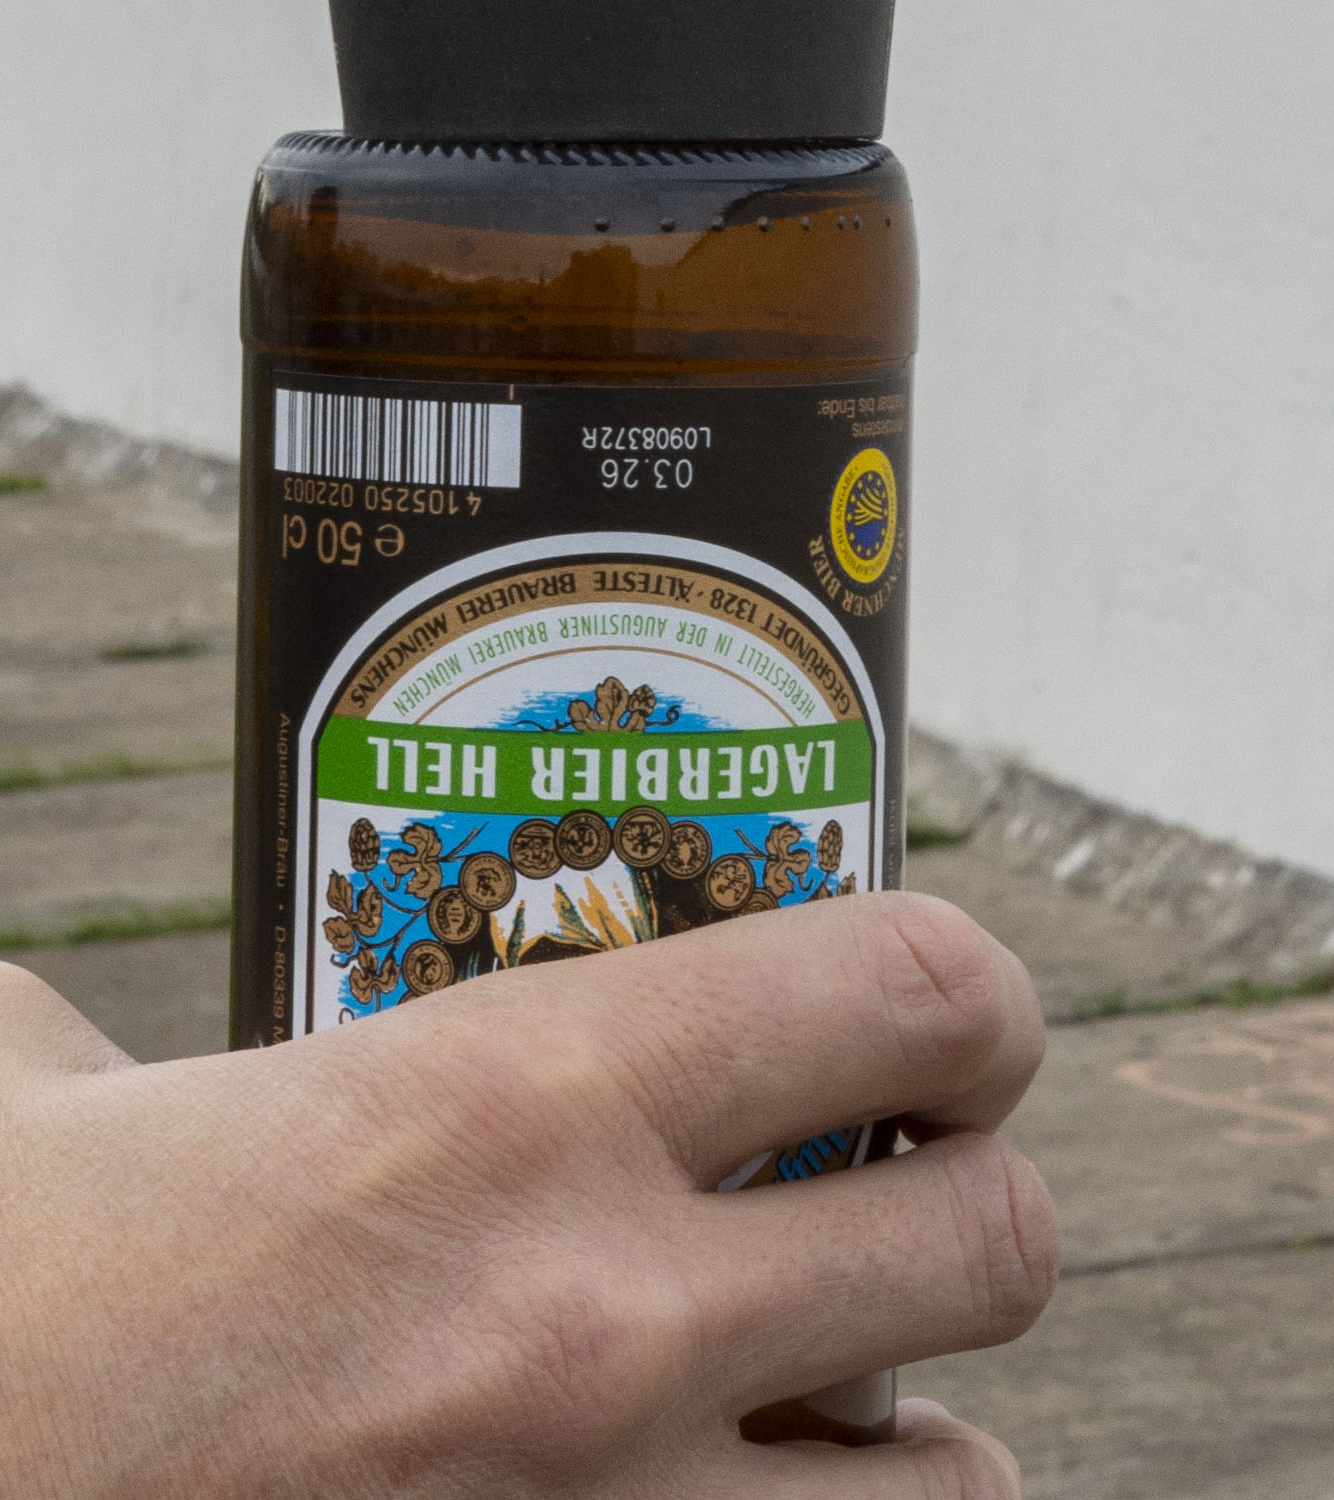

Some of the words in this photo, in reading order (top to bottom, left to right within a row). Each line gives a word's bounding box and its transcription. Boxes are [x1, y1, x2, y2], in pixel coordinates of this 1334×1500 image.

[581, 426, 711, 450] L0908372R
[283, 475, 354, 508] 022003
[600, 457, 694, 488] 03.26
[365, 484, 460, 515] 105250
[467, 491, 482, 516] 4
[283, 514, 307, 558] cl
[317, 517, 363, 566] 50
[593, 570, 695, 604] ÄLTESTE
[808, 534, 842, 601] BIER
[454, 572, 576, 622] BRAUEREI
[710, 587, 758, 625] 1328
[467, 620, 548, 662] BRAUEREI
[558, 613, 668, 640] AUGUSTINER
[676, 620, 707, 647] DER
[716, 633, 732, 655] IN
[349, 615, 450, 710] MÜNCHENS
[391, 653, 463, 716] MÜNCHEN
[738, 644, 816, 721] HERGESTELLT
[760, 612, 853, 716] GEGRÜNDET
[366, 734, 497, 796] HELL
[530, 739, 837, 802] LAGERBIER
[275, 711, 294, 889] Augustiner-Bräu
[272, 925, 287, 1020] D-80339
